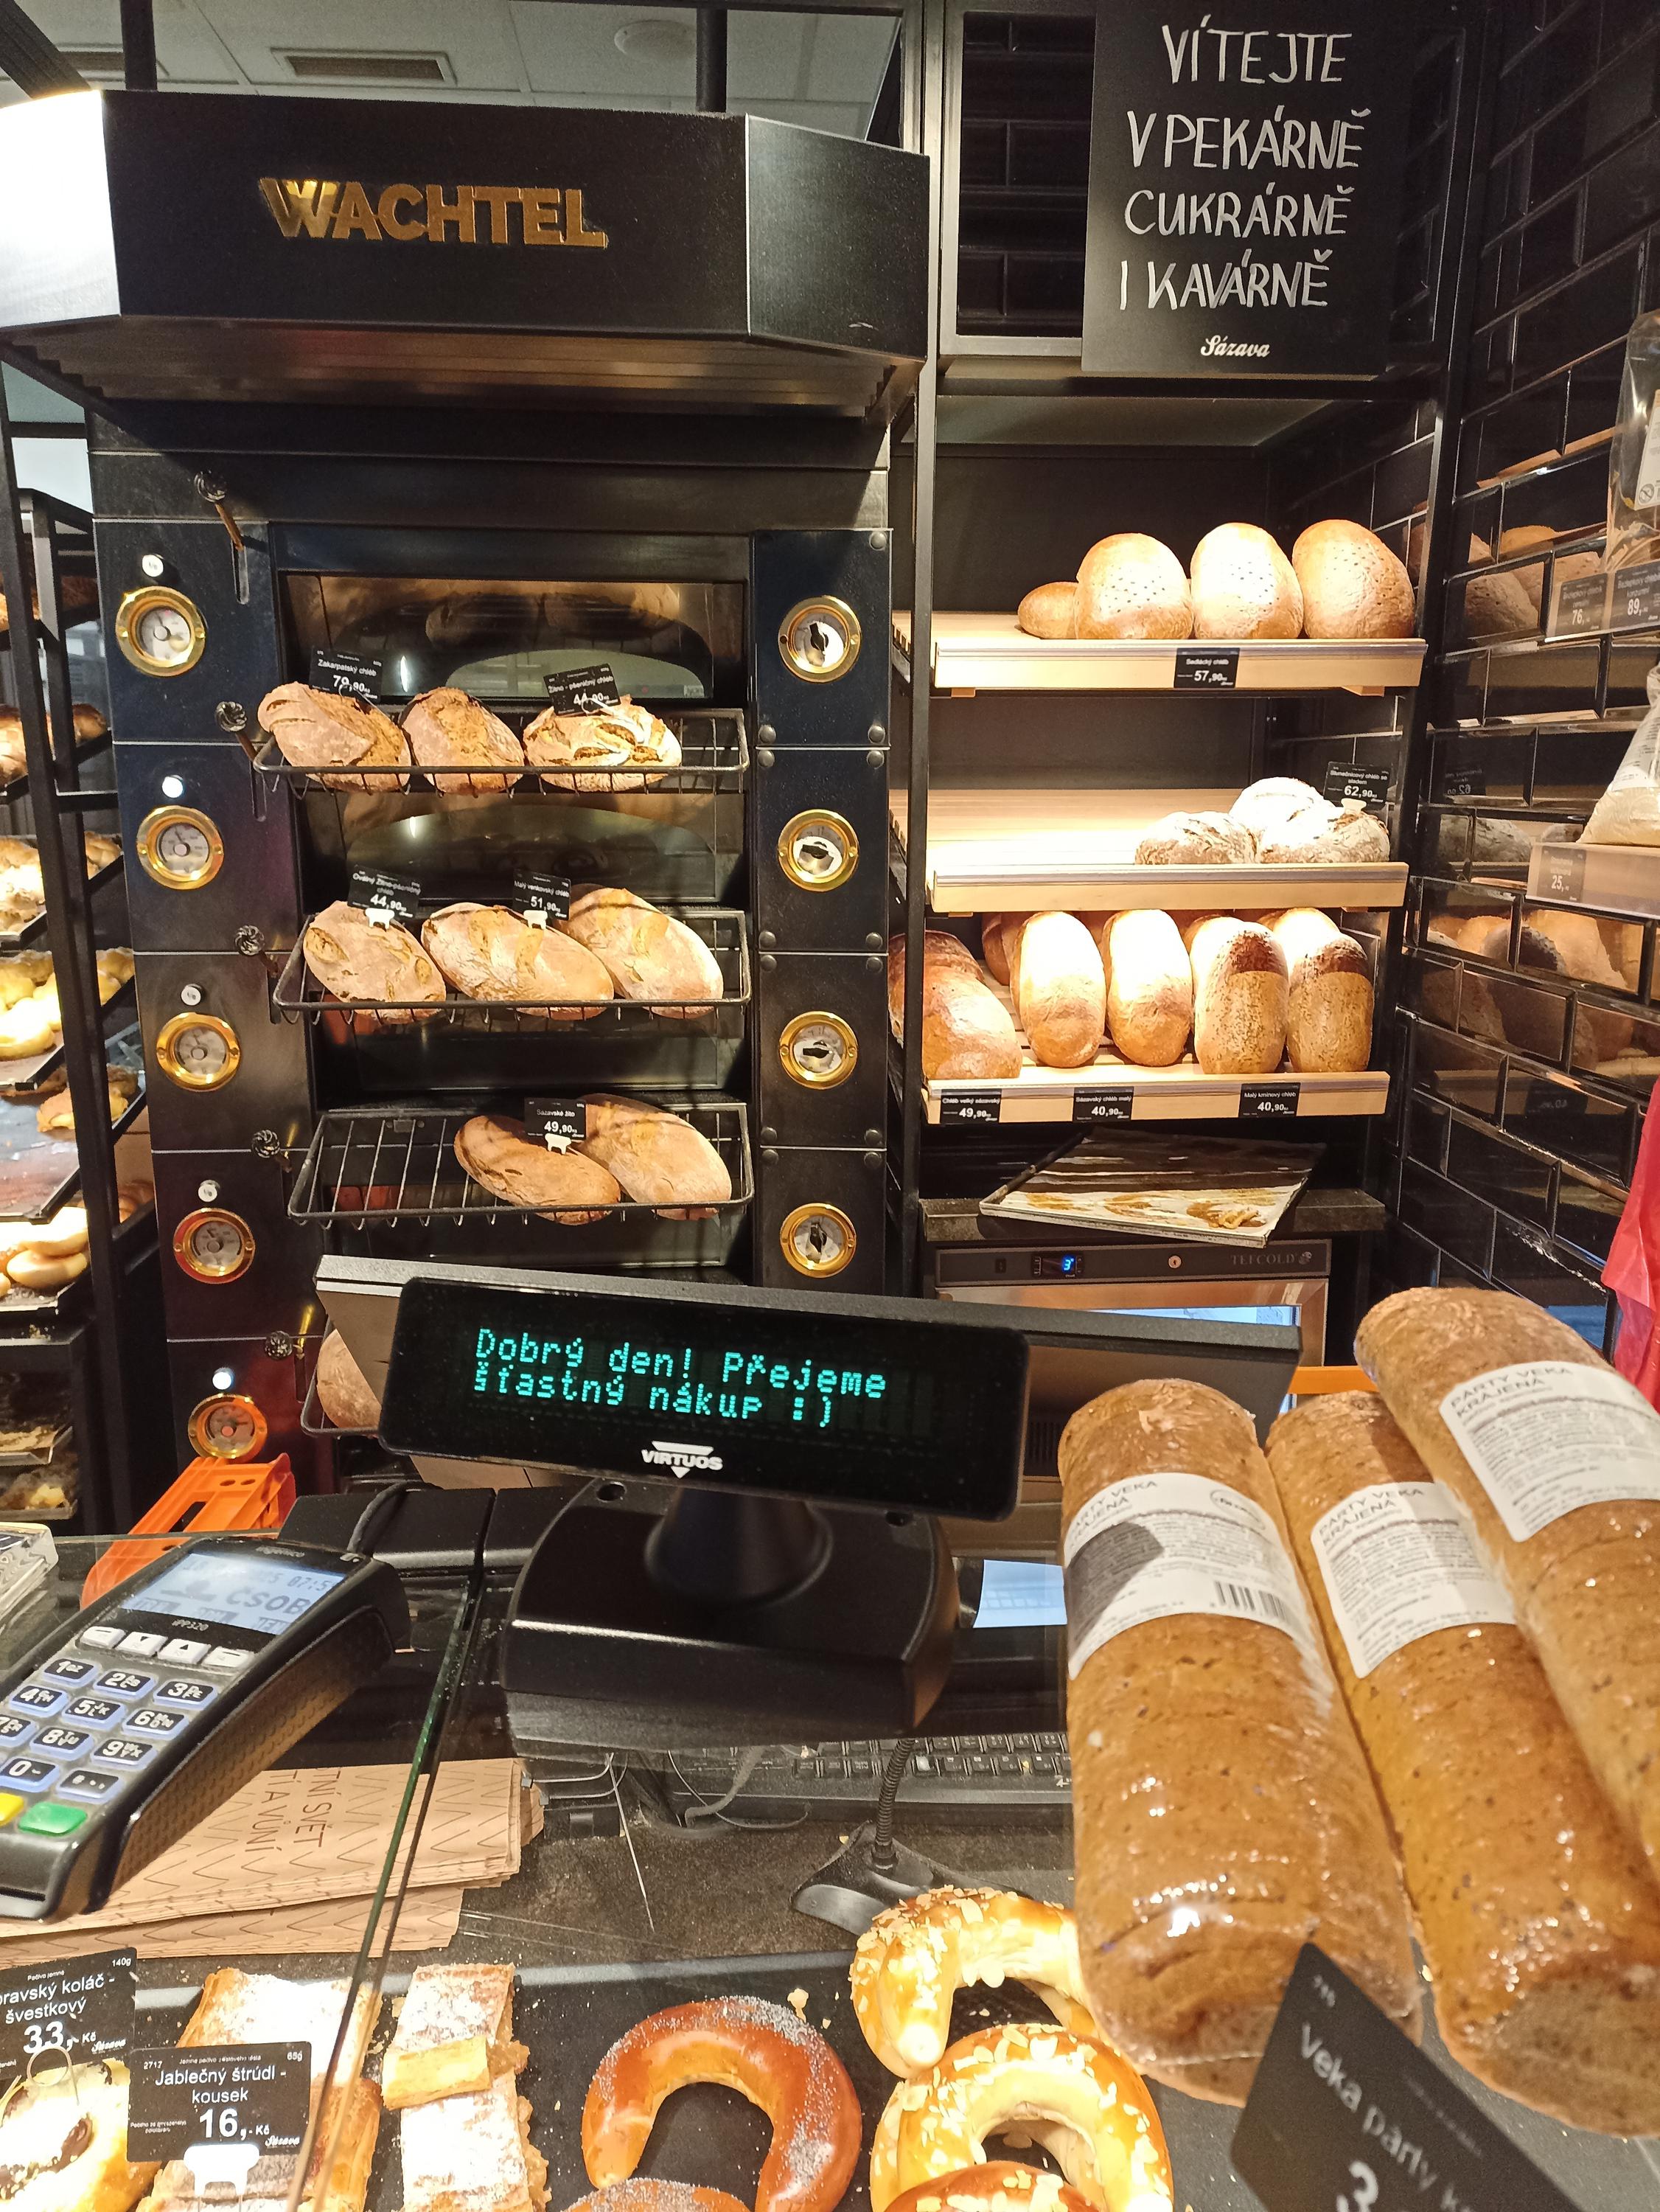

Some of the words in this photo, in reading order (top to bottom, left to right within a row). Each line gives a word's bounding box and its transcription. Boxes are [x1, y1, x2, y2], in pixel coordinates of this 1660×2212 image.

[1162, 14, 1352, 84] VÍTEJTE
[1127, 111, 1157, 167] V
[1165, 105, 1371, 170] PEKÁRNĚ
[259, 177, 609, 249] WACHTEL
[1124, 181, 1355, 237] CUKRÁRNĚ
[1120, 260, 1128, 310] I
[1148, 248, 1333, 310] KAVÁRNĚ
[1200, 335, 1271, 358] Sázava
[1344, 785, 1373, 799] 62,90
[531, 896, 556, 911] 51,90
[959, 1107, 986, 1119] 49,90
[1091, 1106, 1119, 1116] 40,90
[1258, 1102, 1284, 1112] 40,90
[544, 1121, 573, 1134] 49,90
[475, 1328, 584, 1368] Dobrý
[609, 1341, 691, 1380] den!
[722, 1352, 886, 1399] Přejeme
[649, 1382, 763, 1419] nákup
[792, 1396, 831, 1428] :)
[641, 1449, 723, 1471] VIRTUOS
[105, 1672, 126, 1686] 2
[20, 1688, 40, 1701] 4
[167, 1683, 188, 1697] 3
[74, 1700, 96, 1714] 5
[134, 1711, 155, 1725] 6
[42, 1729, 64, 1744] 8
[102, 1741, 124, 1756] 9
[245, 1804, 291, 1852] VŮNÍ
[293, 1802, 333, 1847] SVĚT
[112, 1957, 131, 1966] 140g
[62, 1973, 105, 1994] koláč
[5, 1996, 87, 2024] švestkový
[82, 2032, 97, 2043] Kč
[155, 2067, 226, 2085] Jablečný
[232, 2065, 275, 2081] štrúdl
[1301, 2022, 1363, 2112] Veka
[192, 2087, 248, 2104] kousek
[255, 2124, 270, 2135] Kč
